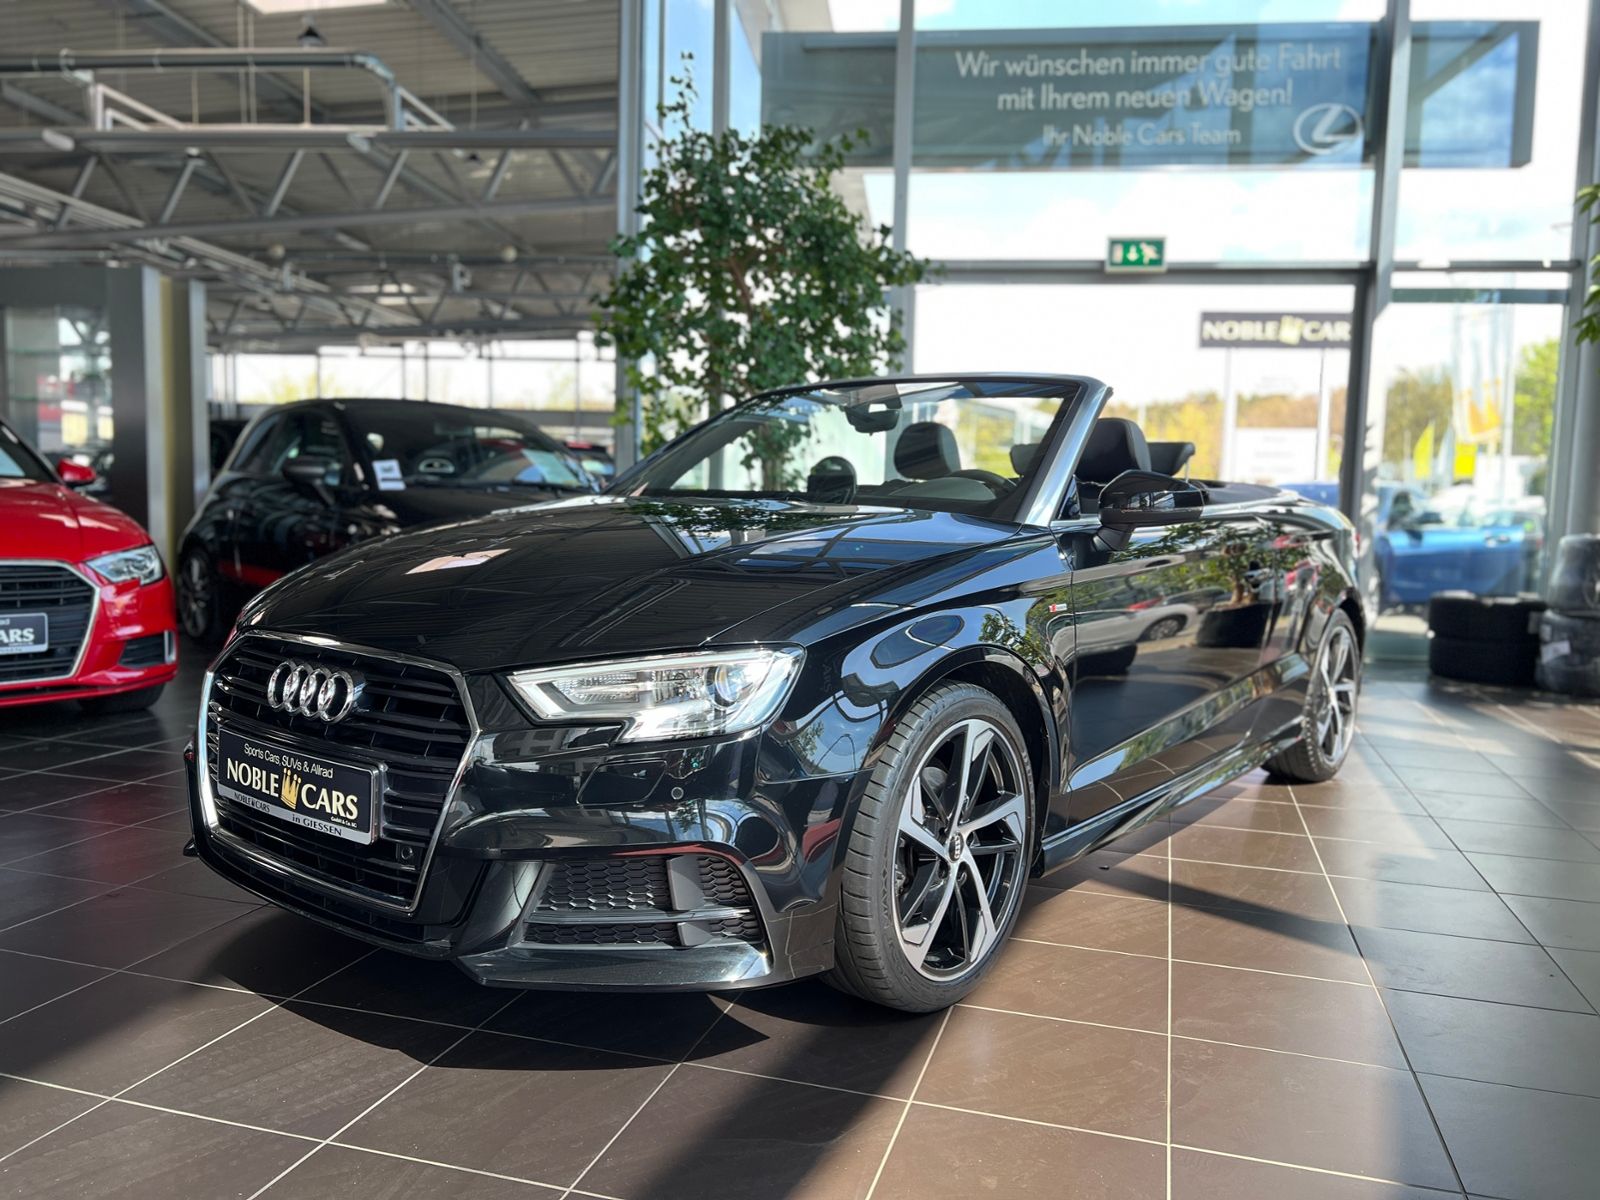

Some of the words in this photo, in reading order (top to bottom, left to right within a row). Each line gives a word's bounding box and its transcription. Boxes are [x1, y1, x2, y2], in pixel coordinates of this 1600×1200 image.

[955, 49, 999, 77] Wir
[1004, 48, 1125, 77] wünschen
[1130, 51, 1207, 75] immer
[1215, 48, 1271, 77] gute
[1278, 42, 1342, 71] Fahrt
[997, 87, 1035, 110] mit
[1040, 83, 1110, 110] Ihrem
[1115, 89, 1191, 109] neuen
[1197, 78, 1294, 112] Wagen!
[1042, 124, 1070, 146] Ihr
[1072, 123, 1133, 146] Noble
[1137, 122, 1186, 146] Cars
[1190, 121, 1242, 145] Team
[1201, 319, 1280, 341] NOBLE
[244, 743, 264, 760] Sports
[281, 755, 302, 771] SUVs
[310, 763, 334, 779] Allrad
[227, 757, 279, 798] NOBLE
[301, 783, 358, 820] CARS
[292, 814, 301, 823] in
[302, 818, 342, 837] GIESSEN
